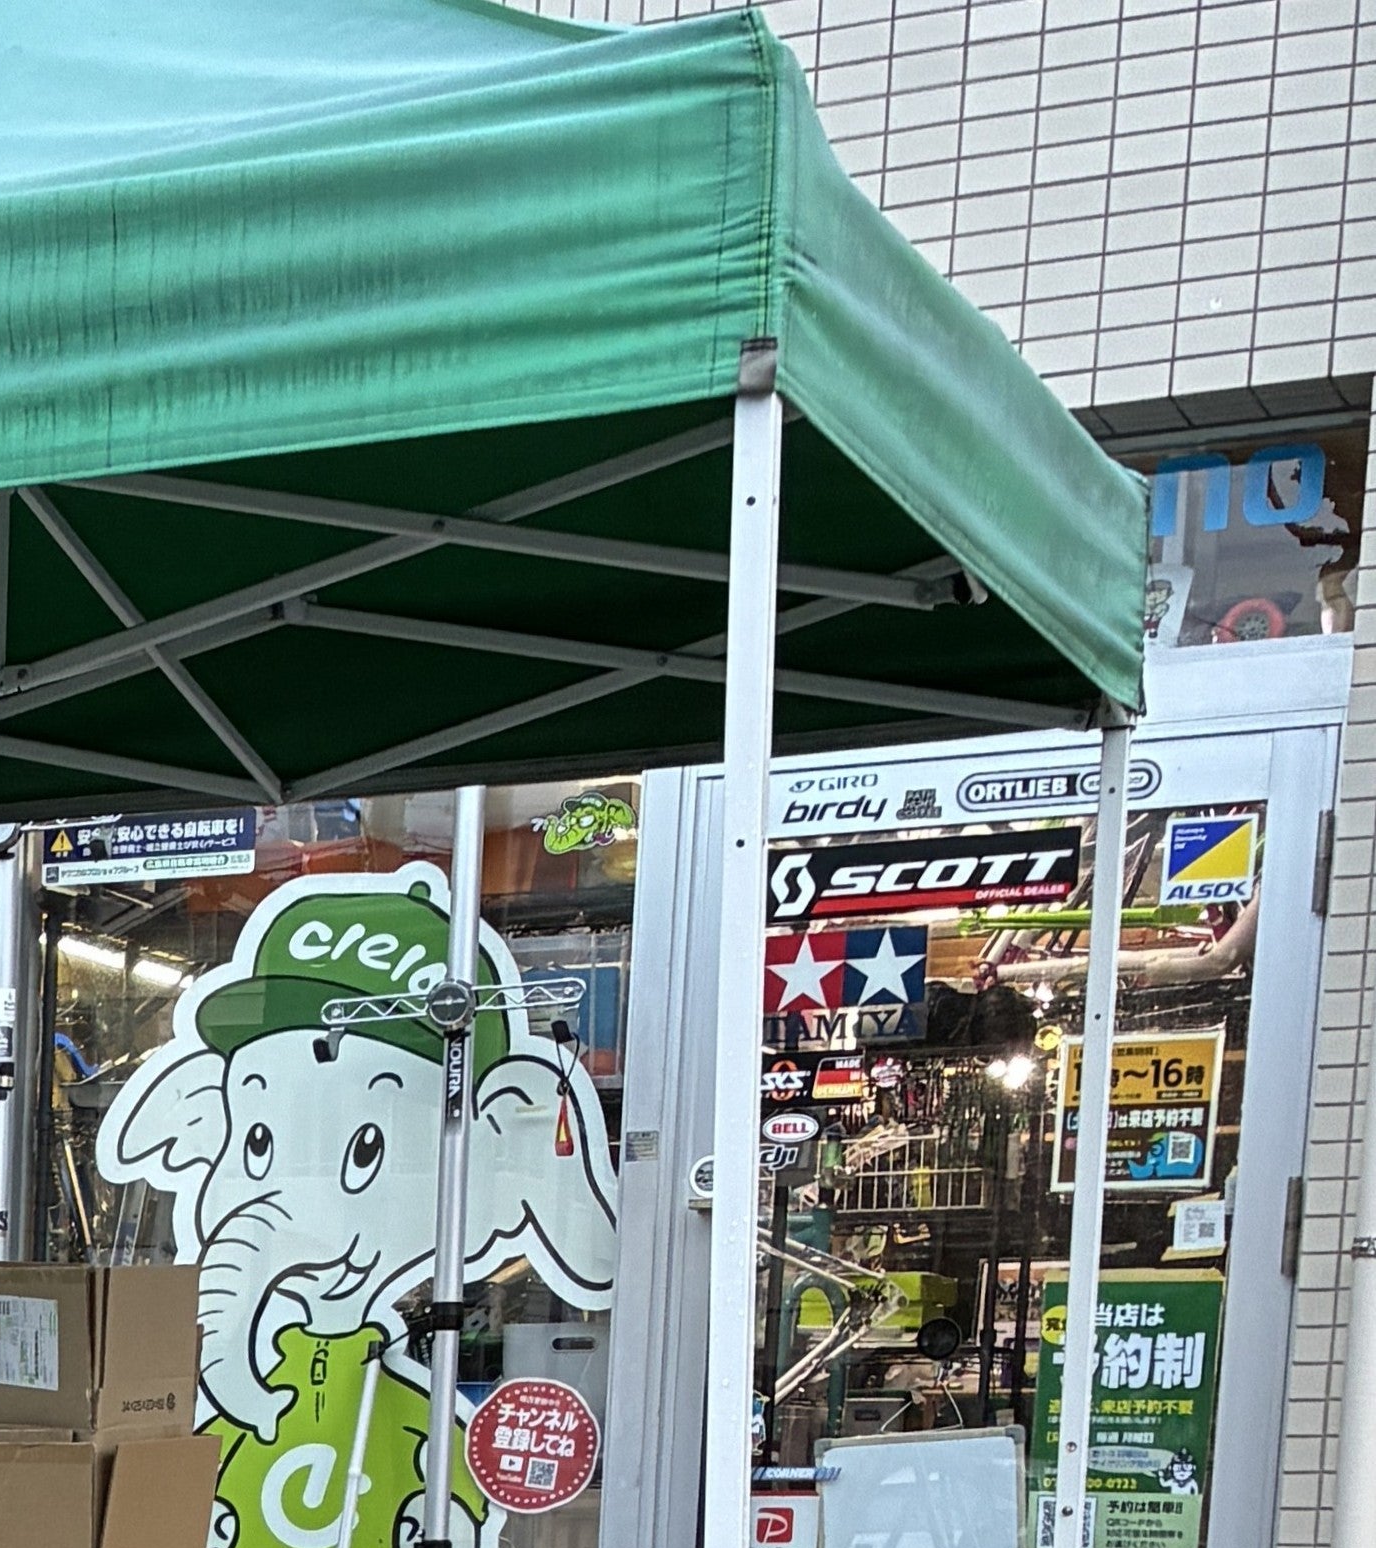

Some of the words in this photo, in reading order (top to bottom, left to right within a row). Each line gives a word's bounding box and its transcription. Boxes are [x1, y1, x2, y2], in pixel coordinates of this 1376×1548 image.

[819, 773, 878, 791] GIRO
[968, 776, 1068, 802] ORTLIEB
[782, 795, 888, 824] birdy
[820, 849, 1074, 898] SCOTT
[975, 887, 1022, 900] OFFICIAL
[1024, 883, 1065, 897] DEALER
[1167, 881, 1247, 900] ALSOK
[762, 1008, 920, 1045] TAMIYA
[771, 1121, 809, 1135] BELL
[760, 1145, 798, 1170] dji
[1094, 1302, 1166, 1328] 当店は
[497, 1403, 580, 1433] チャンネル
[492, 1425, 576, 1458] 登録してね
